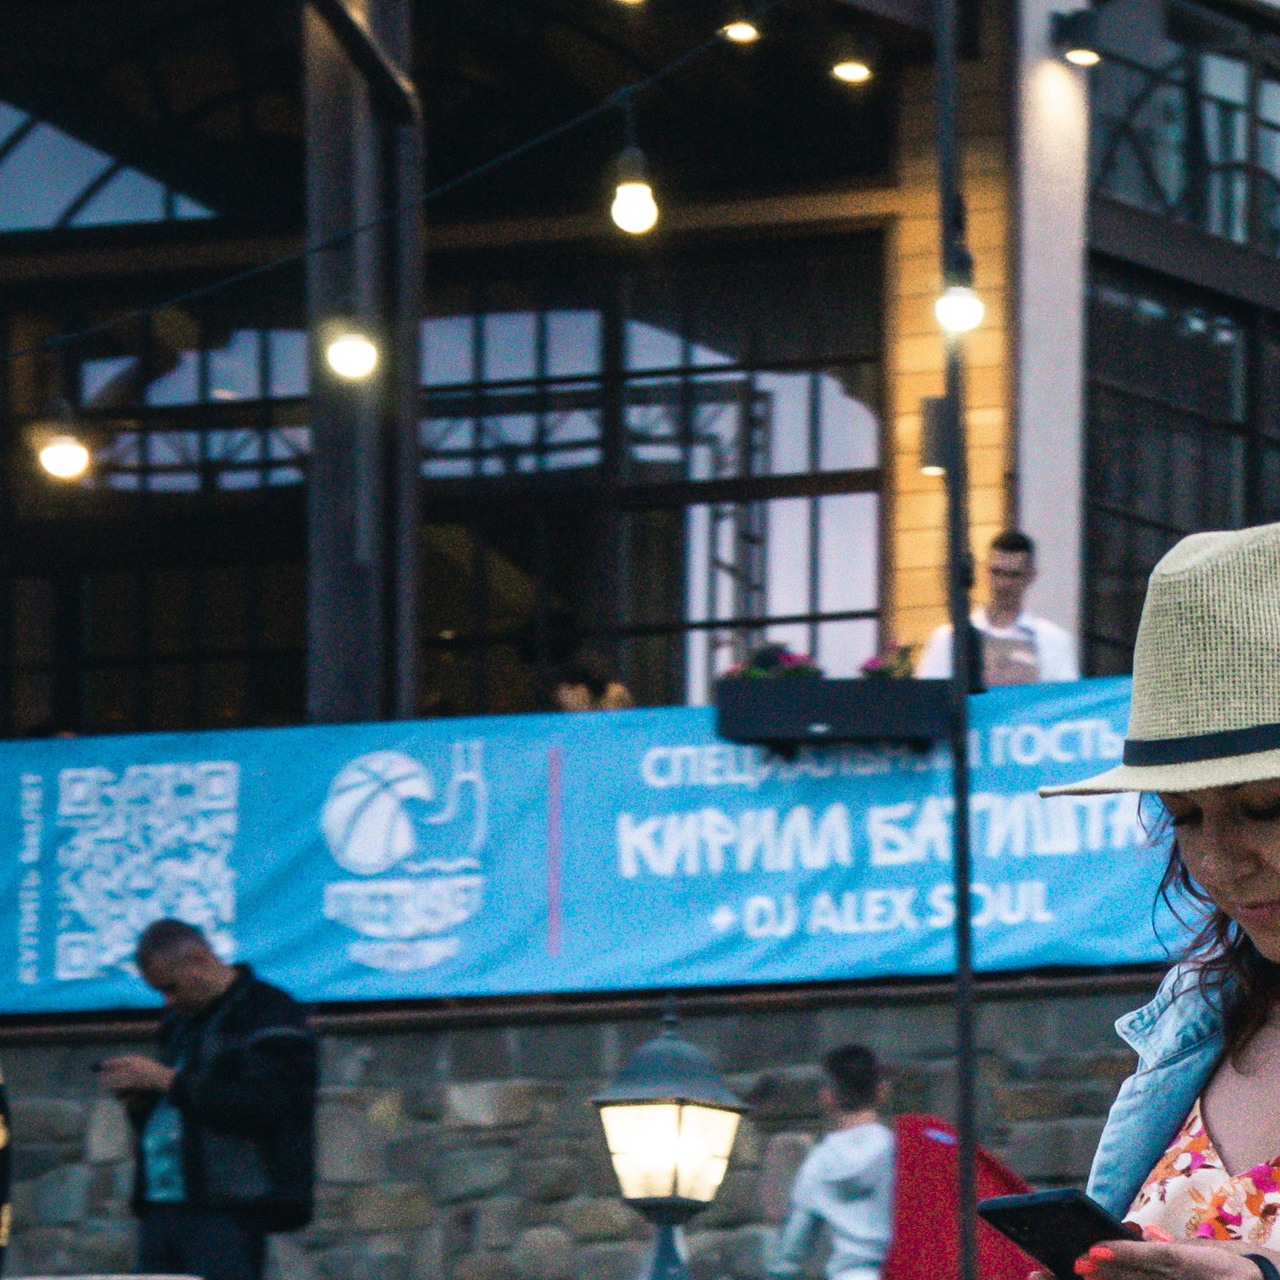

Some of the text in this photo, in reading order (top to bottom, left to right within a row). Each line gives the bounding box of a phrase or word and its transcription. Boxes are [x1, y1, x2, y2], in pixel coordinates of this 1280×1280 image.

[990, 719, 1124, 766] ГОСТЬ
[617, 801, 853, 878] КИРИЛЛ
[743, 894, 797, 938] DJ
[807, 887, 918, 935] ALEX
[929, 881, 1055, 928] SOUL
